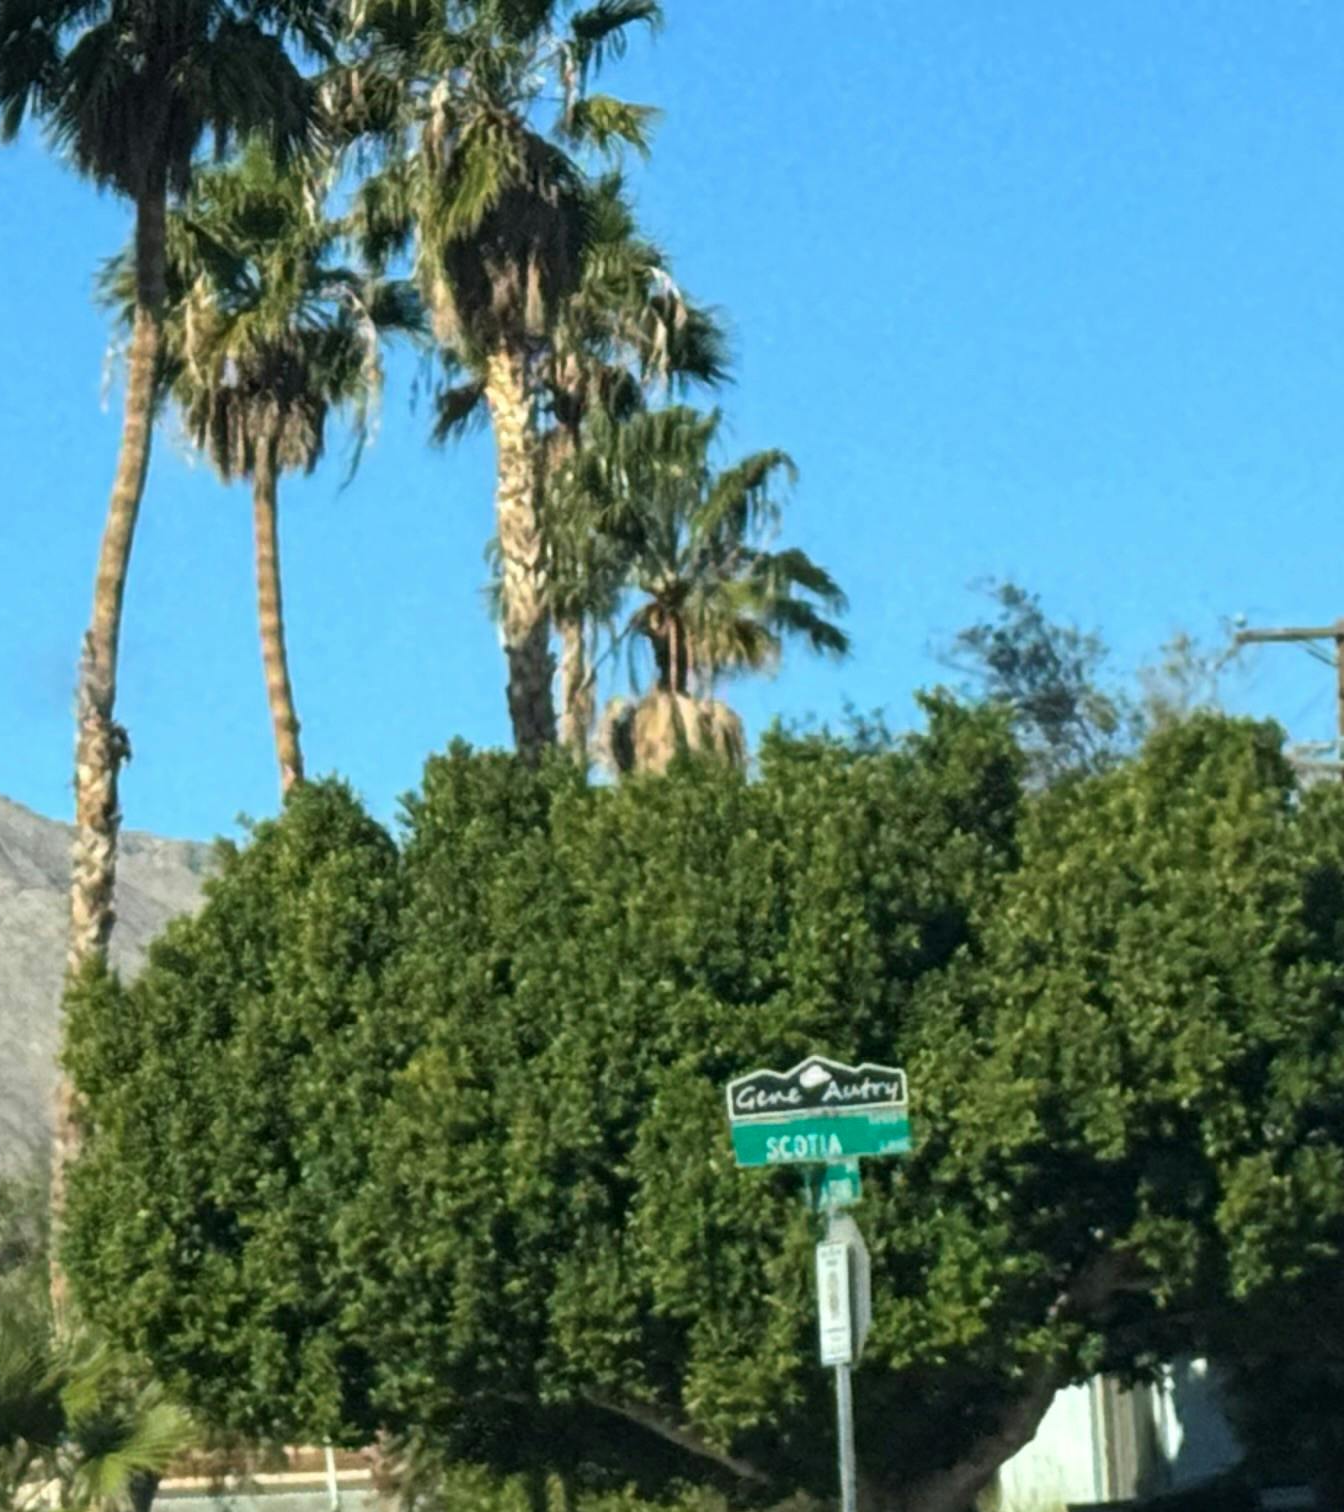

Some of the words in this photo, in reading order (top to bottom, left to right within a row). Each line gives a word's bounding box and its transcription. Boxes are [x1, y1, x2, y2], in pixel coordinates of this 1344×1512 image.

[735, 1085, 803, 1110] Gene
[821, 1076, 899, 1101] Autry
[766, 1133, 843, 1161] SCOTIA
